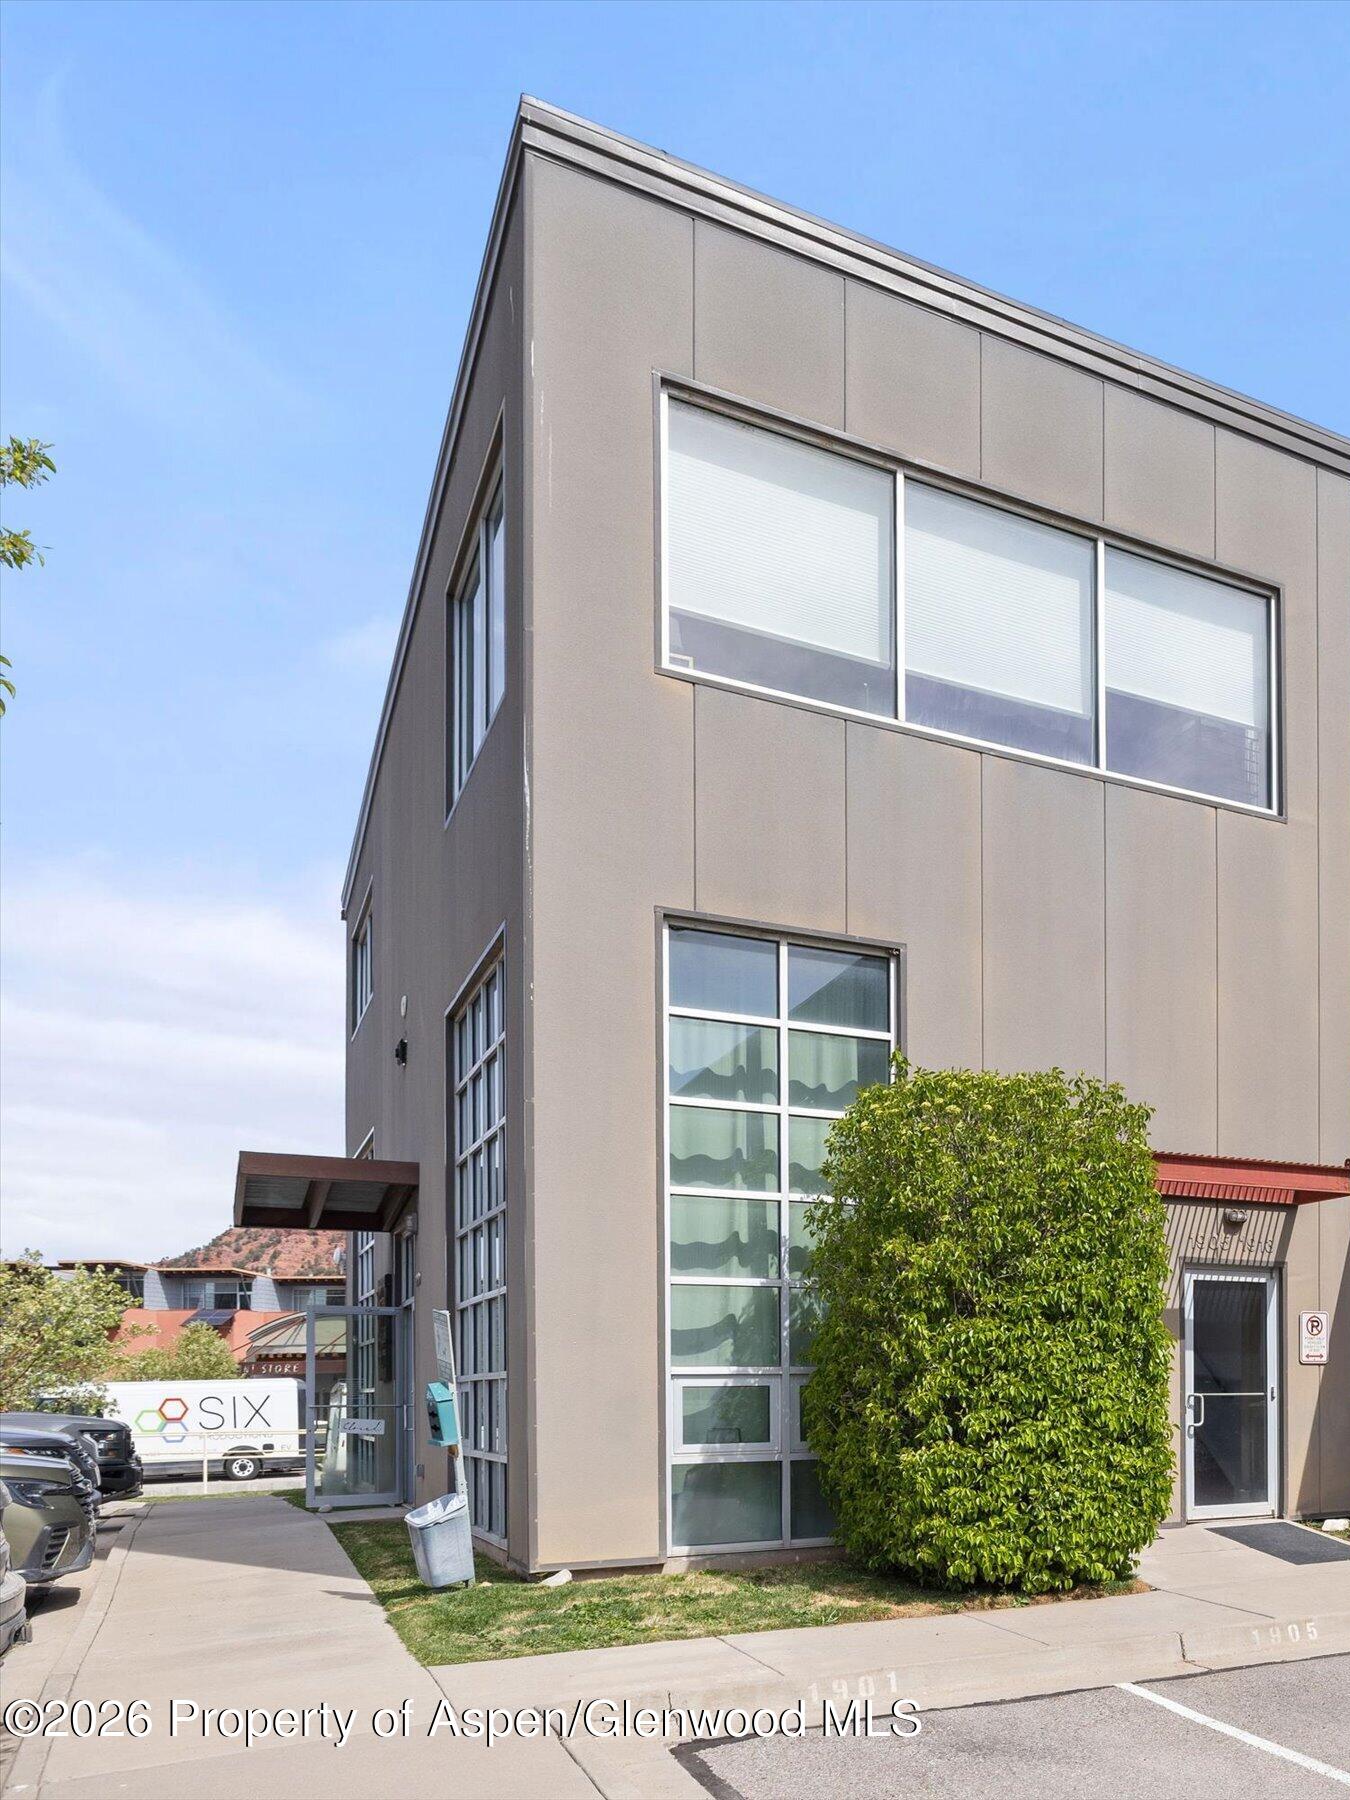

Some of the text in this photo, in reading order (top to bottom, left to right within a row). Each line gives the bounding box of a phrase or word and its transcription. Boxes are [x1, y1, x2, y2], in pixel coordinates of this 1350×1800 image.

[261, 1363, 300, 1374] STORE
[199, 1395, 271, 1430] SIX
[807, 1670, 898, 1702] 1901
